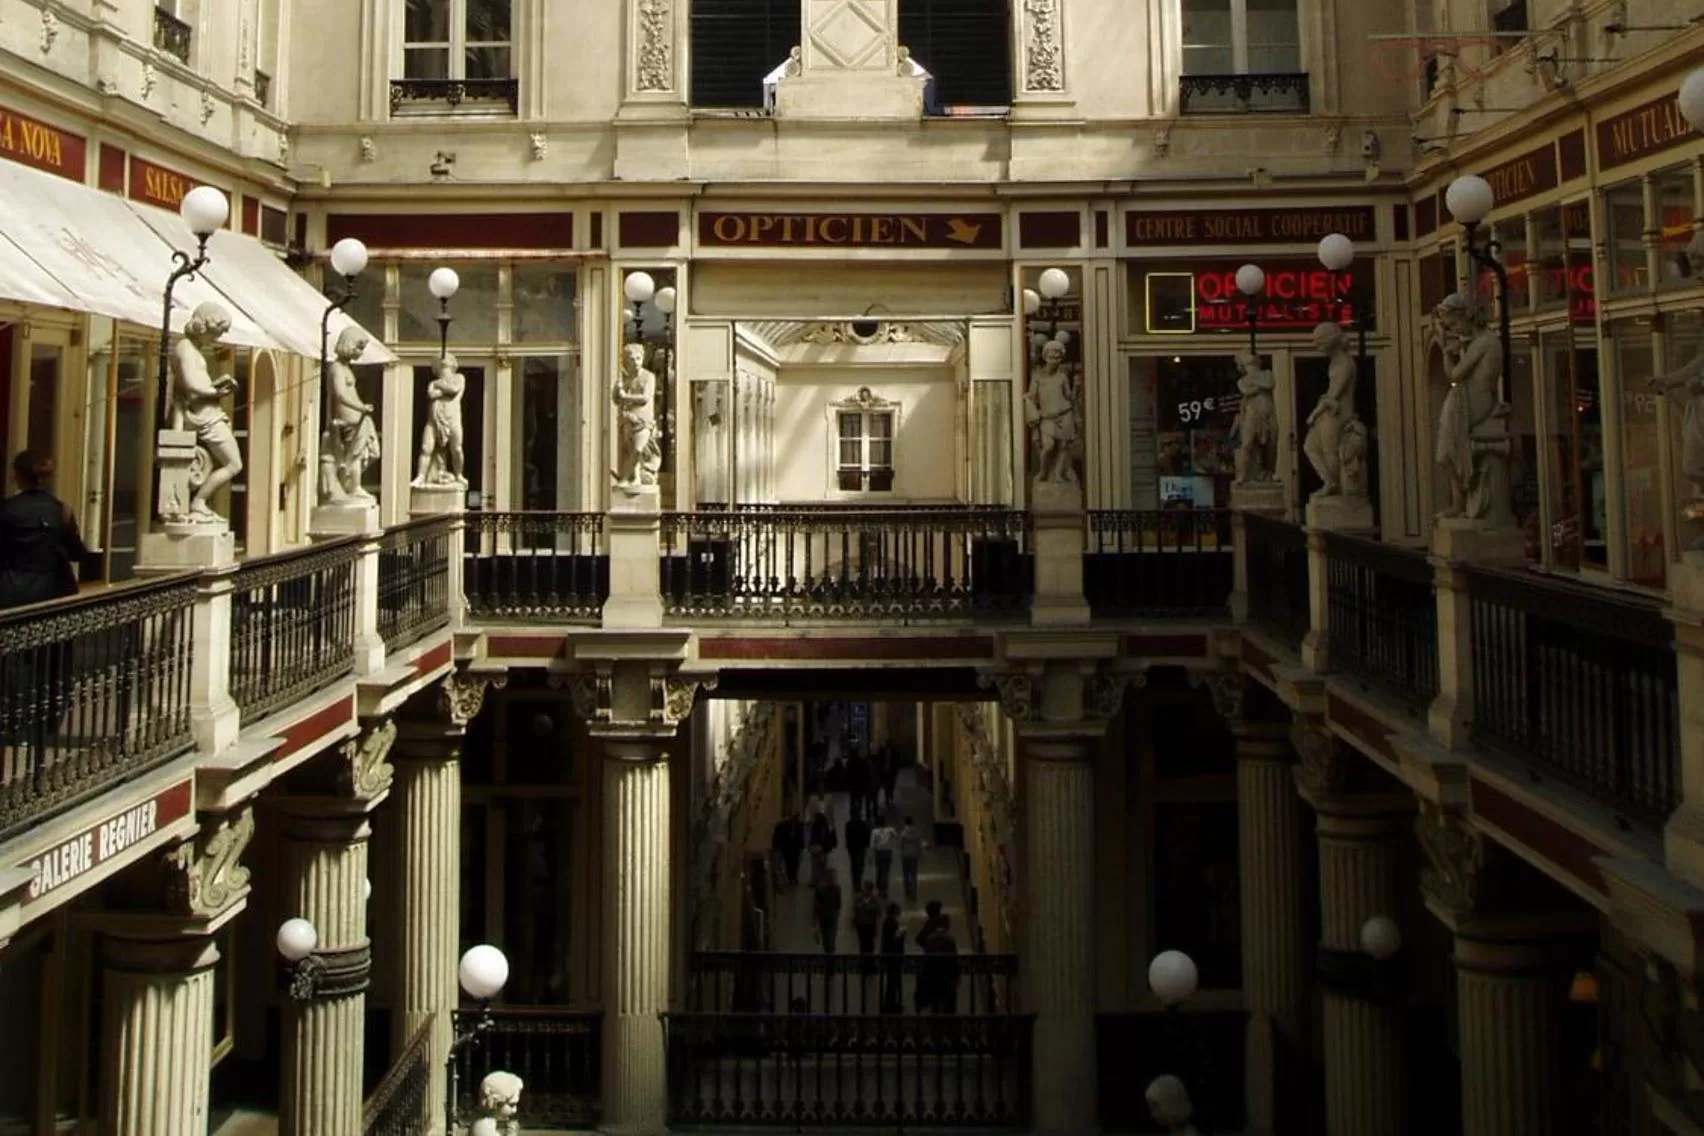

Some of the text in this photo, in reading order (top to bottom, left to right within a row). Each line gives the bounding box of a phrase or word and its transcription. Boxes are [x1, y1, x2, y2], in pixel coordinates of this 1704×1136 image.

[20, 120, 62, 166] NOVA
[145, 166, 184, 205] SALSA
[713, 214, 927, 243] OPTICIEN
[1135, 216, 1196, 240] CENTRE
[1204, 215, 1262, 238] SOCIAL
[1198, 271, 1353, 300] OPICIEN
[1177, 396, 1216, 424] 59€
[29, 799, 157, 898] GALERIE REGNIER
